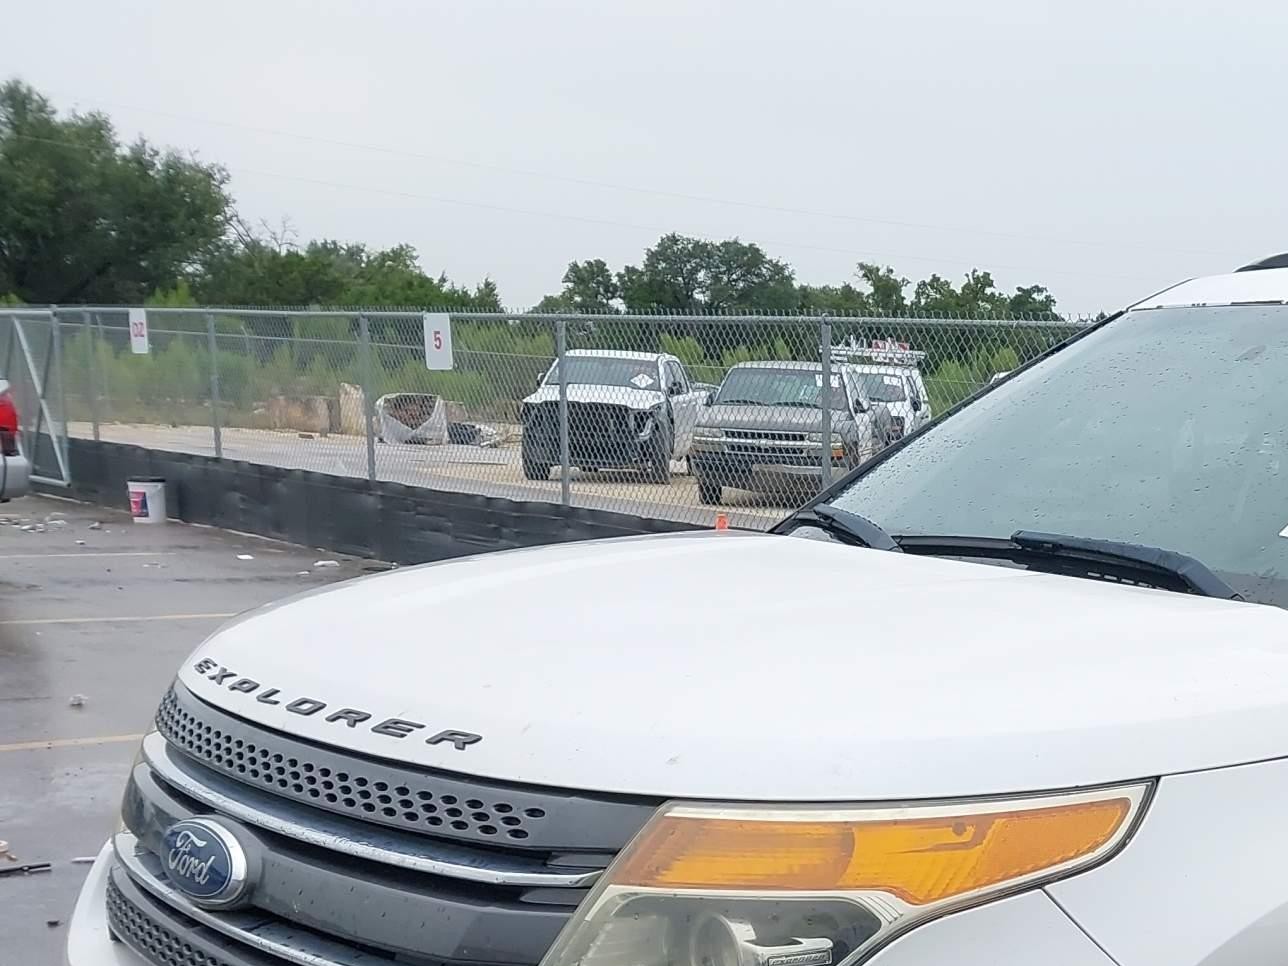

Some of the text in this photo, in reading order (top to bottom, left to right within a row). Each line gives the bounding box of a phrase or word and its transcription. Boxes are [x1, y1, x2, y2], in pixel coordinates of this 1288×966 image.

[433, 330, 442, 350] 5
[193, 657, 484, 751] EXPLORER
[166, 829, 218, 886] Ford
